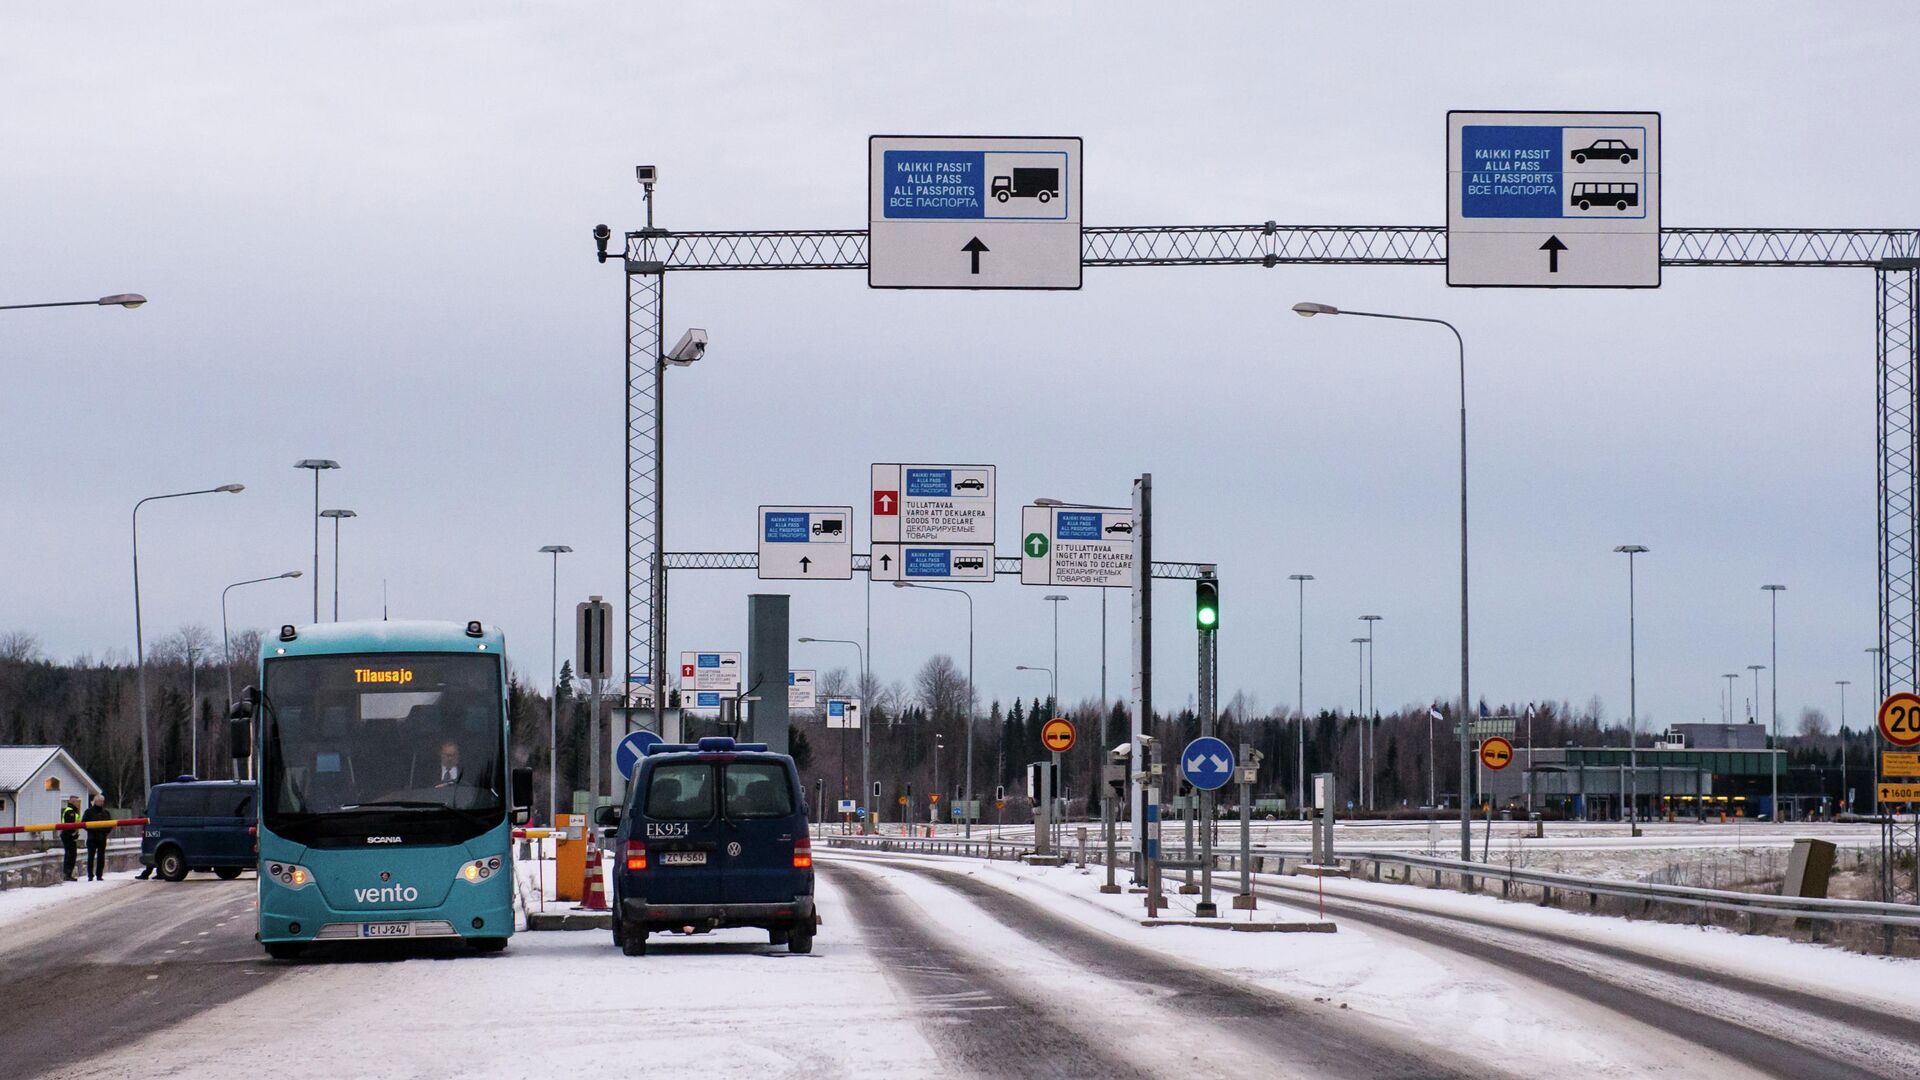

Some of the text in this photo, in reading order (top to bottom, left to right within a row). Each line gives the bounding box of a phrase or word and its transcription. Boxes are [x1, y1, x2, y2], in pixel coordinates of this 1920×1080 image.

[1476, 150, 1550, 159] KAIKKI PASSIT
[898, 163, 972, 172] KAIKKI PASSIT
[1485, 161, 1540, 170] ALLA PASS
[907, 175, 962, 184] ALLA PASS
[1472, 174, 1553, 183] ALL PASSPORTS
[894, 186, 975, 196] ALL PASSPORTS
[1468, 185, 1556, 195] ВСЕ ПАСПОРТА
[890, 198, 978, 207] ВСЕ ПАСПОРТА
[355, 668, 412, 684] Tilausajo
[1891, 705, 1920, 732] 20
[1891, 789, 1912, 798] 1600
[646, 823, 689, 836] EK954
[668, 853, 704, 862] ZCY-560
[354, 883, 418, 903] vento
[370, 925, 407, 935] CIJ-247
